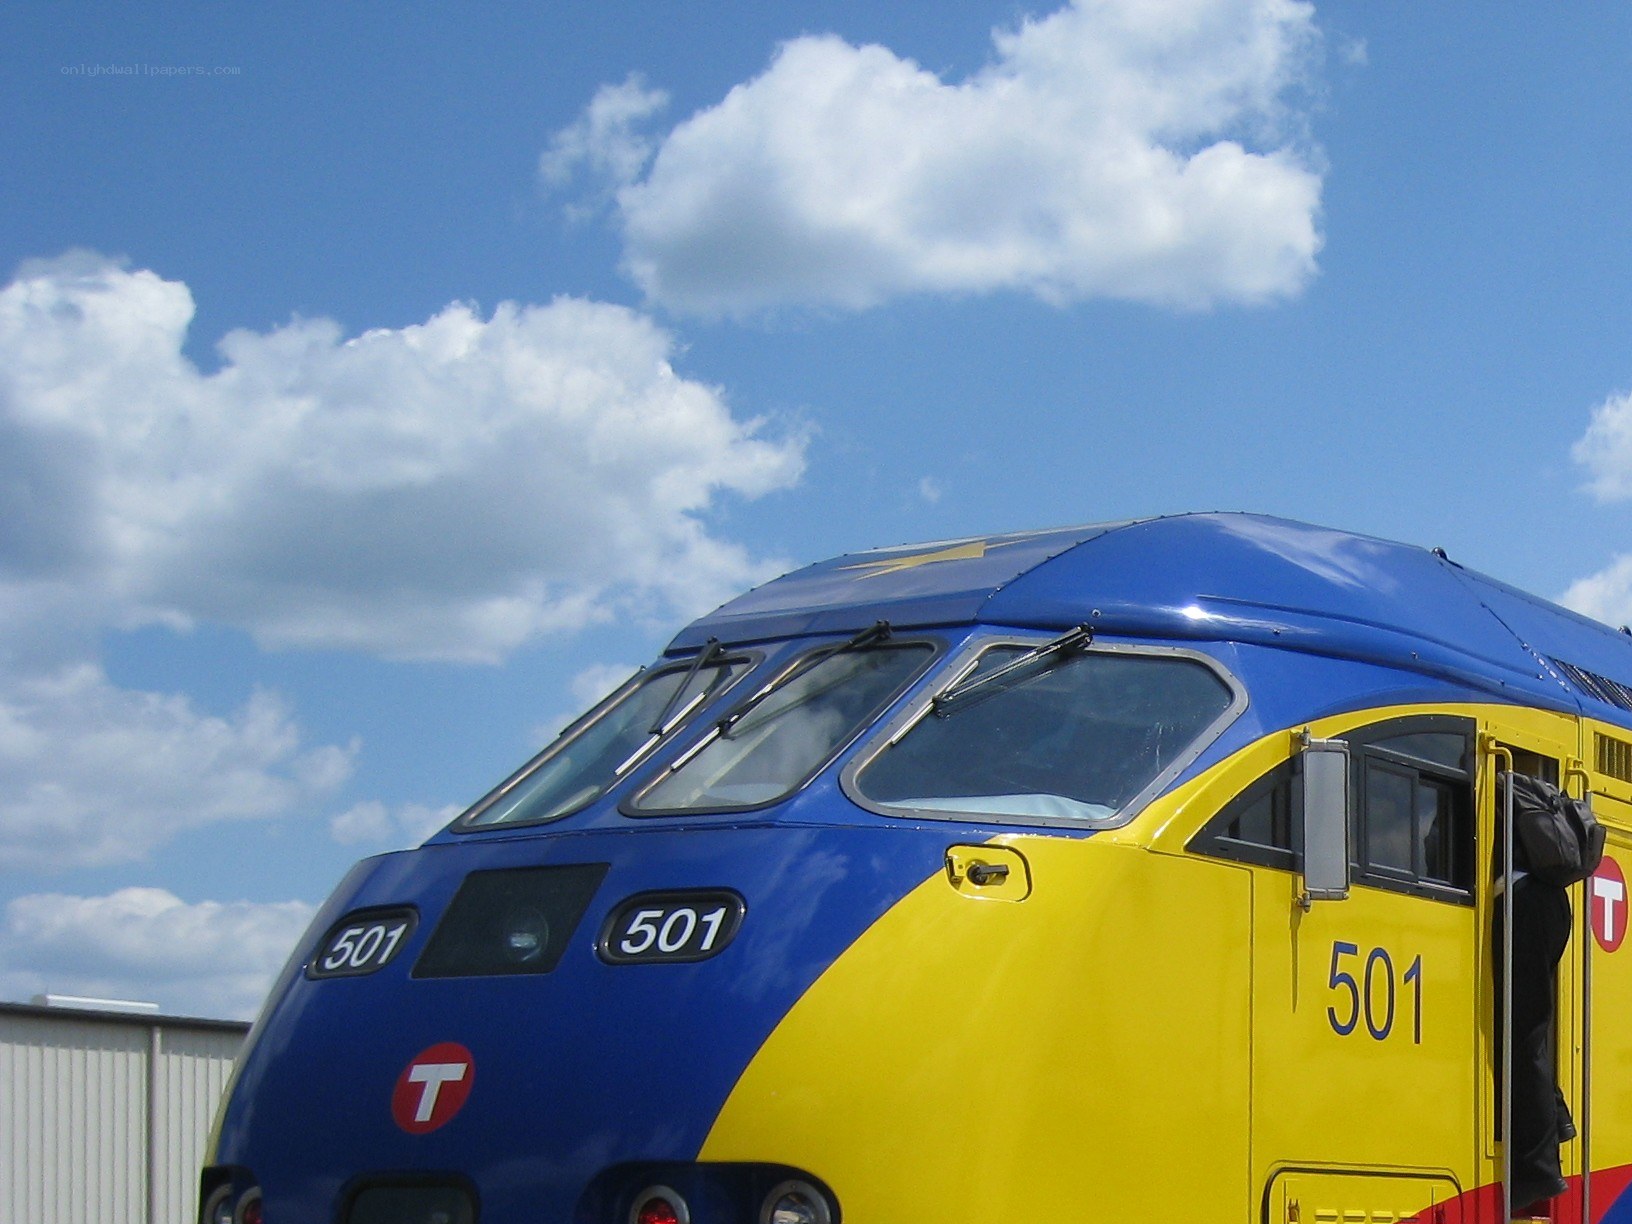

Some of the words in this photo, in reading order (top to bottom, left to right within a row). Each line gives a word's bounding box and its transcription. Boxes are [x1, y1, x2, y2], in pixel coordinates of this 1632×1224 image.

[620, 907, 728, 955] 501
[1593, 876, 1623, 942] T
[324, 922, 408, 971] 501
[1326, 940, 1423, 1045] 501
[407, 1062, 469, 1123] T
